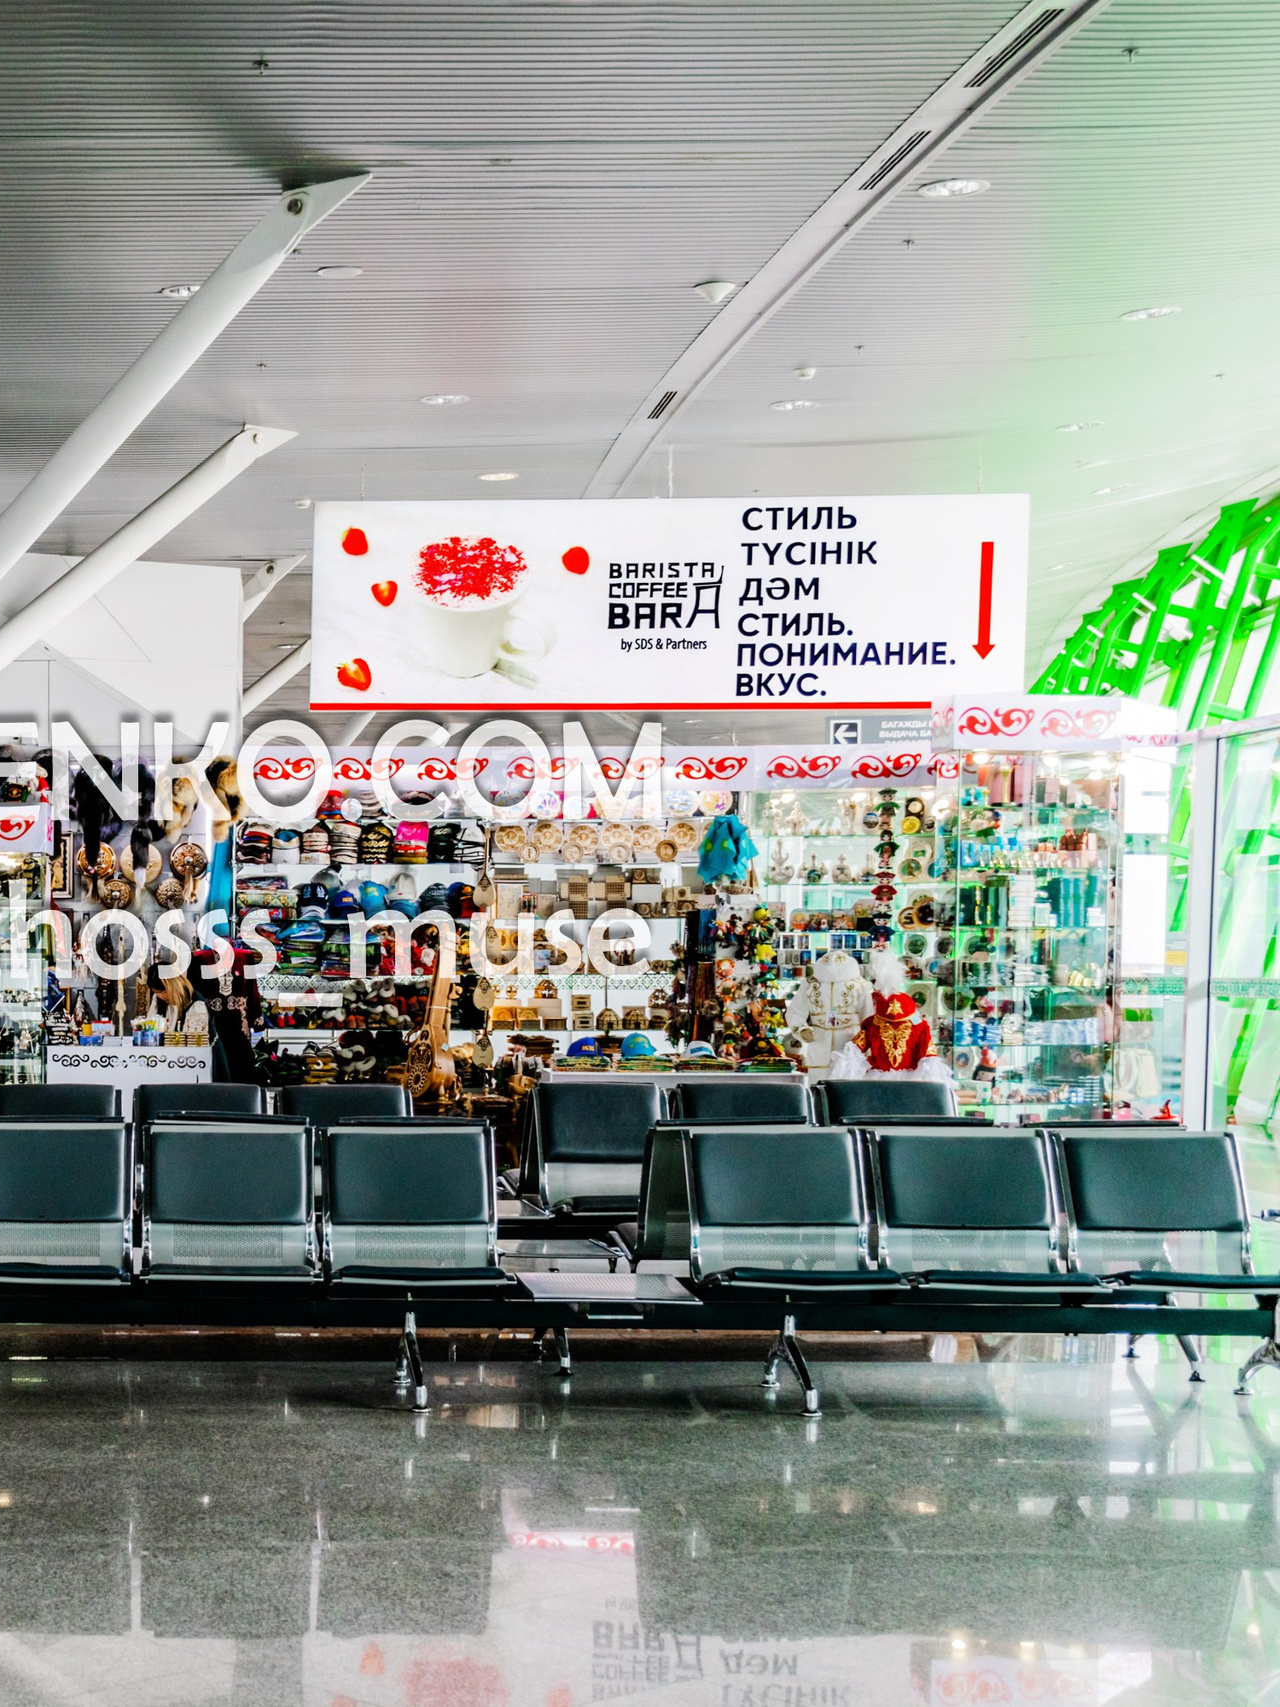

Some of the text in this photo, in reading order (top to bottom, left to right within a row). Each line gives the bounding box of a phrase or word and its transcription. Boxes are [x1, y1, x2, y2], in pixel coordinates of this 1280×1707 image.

[742, 506, 857, 531] СТИЛЬ
[609, 562, 715, 579] BARISTA
[608, 581, 688, 599] COFFEE
[738, 577, 820, 607] ДӘМ
[737, 612, 853, 637] СТИЛЬ.
[620, 637, 708, 653] by SDS & Partners
[737, 641, 956, 667] ПОНИМАНИЕ.
[735, 672, 827, 697] ВКУС.
[879, 730, 918, 739] ВЫДАЧА
